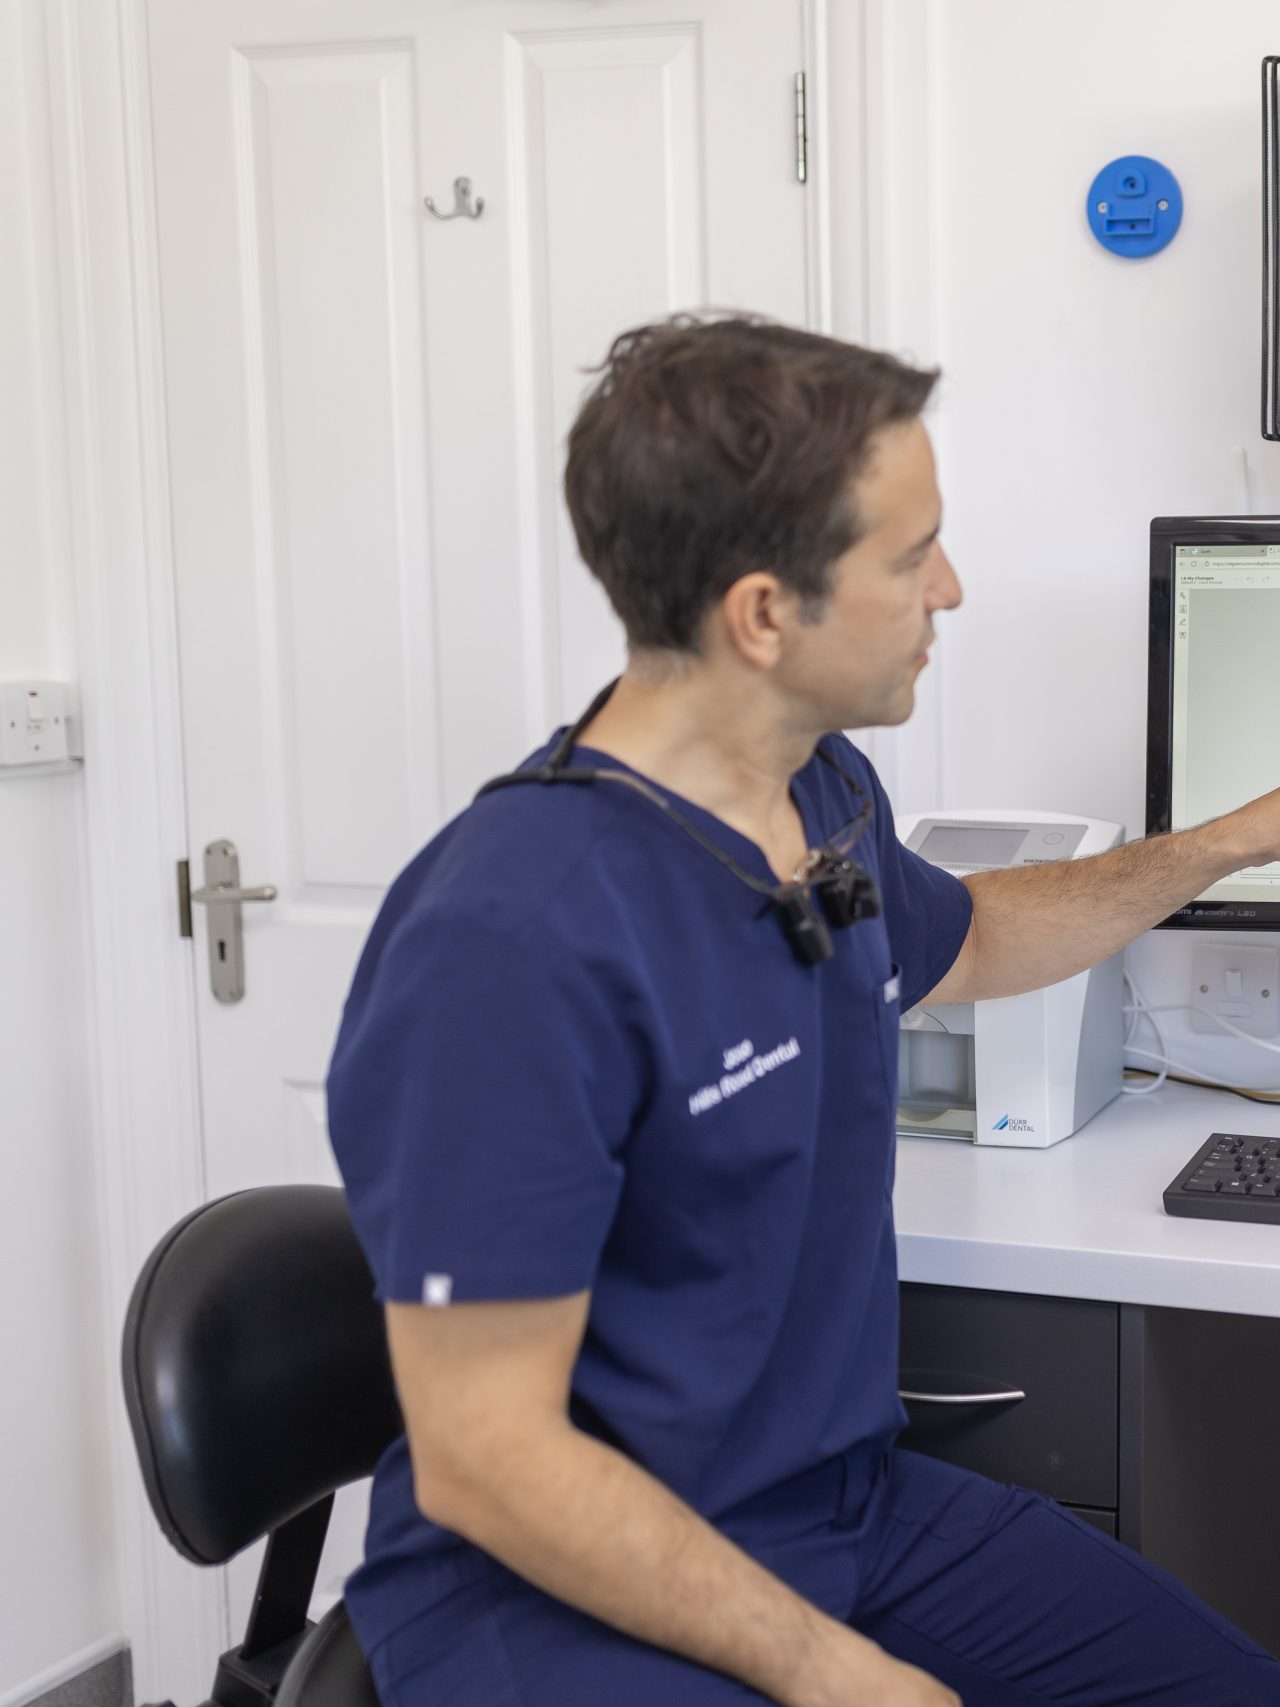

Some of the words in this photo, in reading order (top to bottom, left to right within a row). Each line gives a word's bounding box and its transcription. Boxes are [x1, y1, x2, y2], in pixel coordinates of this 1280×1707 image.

[721, 1058, 757, 1097] Road
[755, 1037, 801, 1077] Dental
[1008, 1125, 1036, 1133] DENTAL
